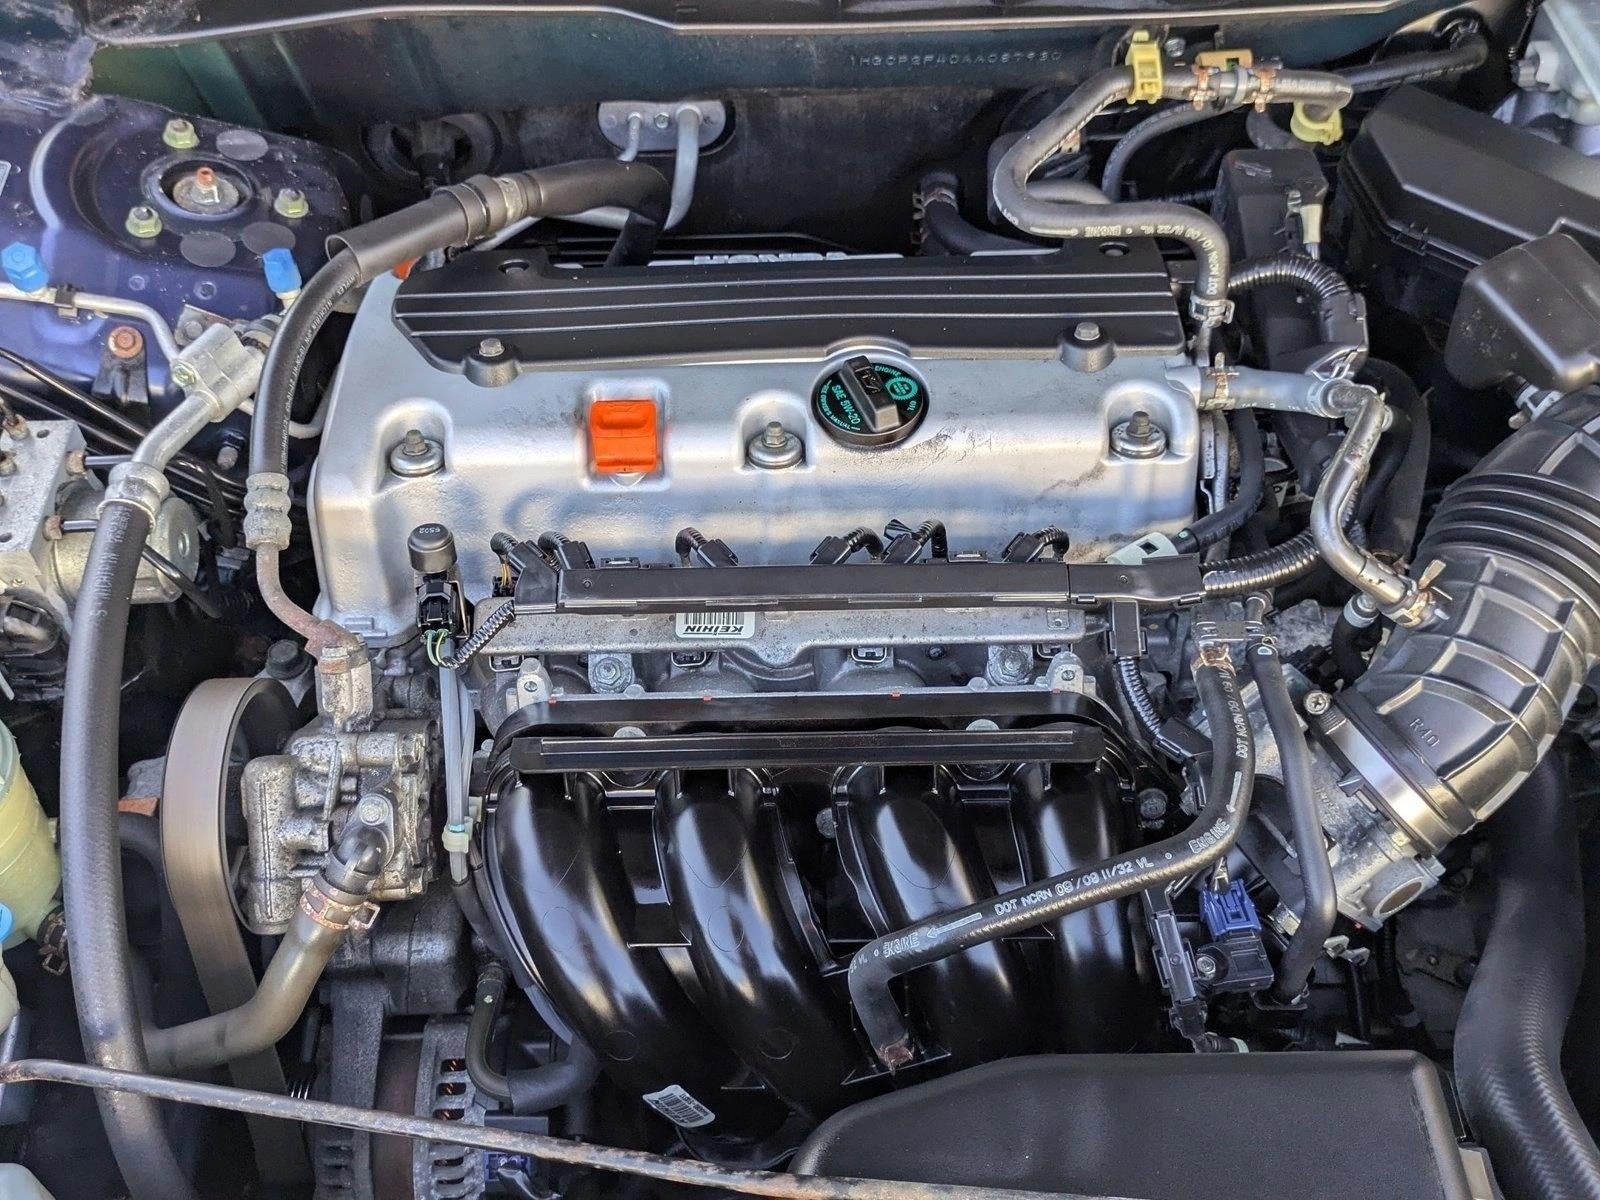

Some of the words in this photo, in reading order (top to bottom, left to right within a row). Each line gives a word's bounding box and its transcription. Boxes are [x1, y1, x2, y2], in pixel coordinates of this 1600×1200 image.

[874, 365, 902, 378] ENGINE
[840, 400, 861, 425] 5W-20
[906, 400, 917, 412] OIL
[684, 625, 745, 634] KEIHIN
[994, 898, 1018, 916] DOT
[1020, 887, 1053, 908] NCRN
[1101, 860, 1134, 881] 11/32
[1136, 855, 1155, 870] VL
[1188, 818, 1230, 854] ENGINE
[1235, 737, 1249, 759] DOT
